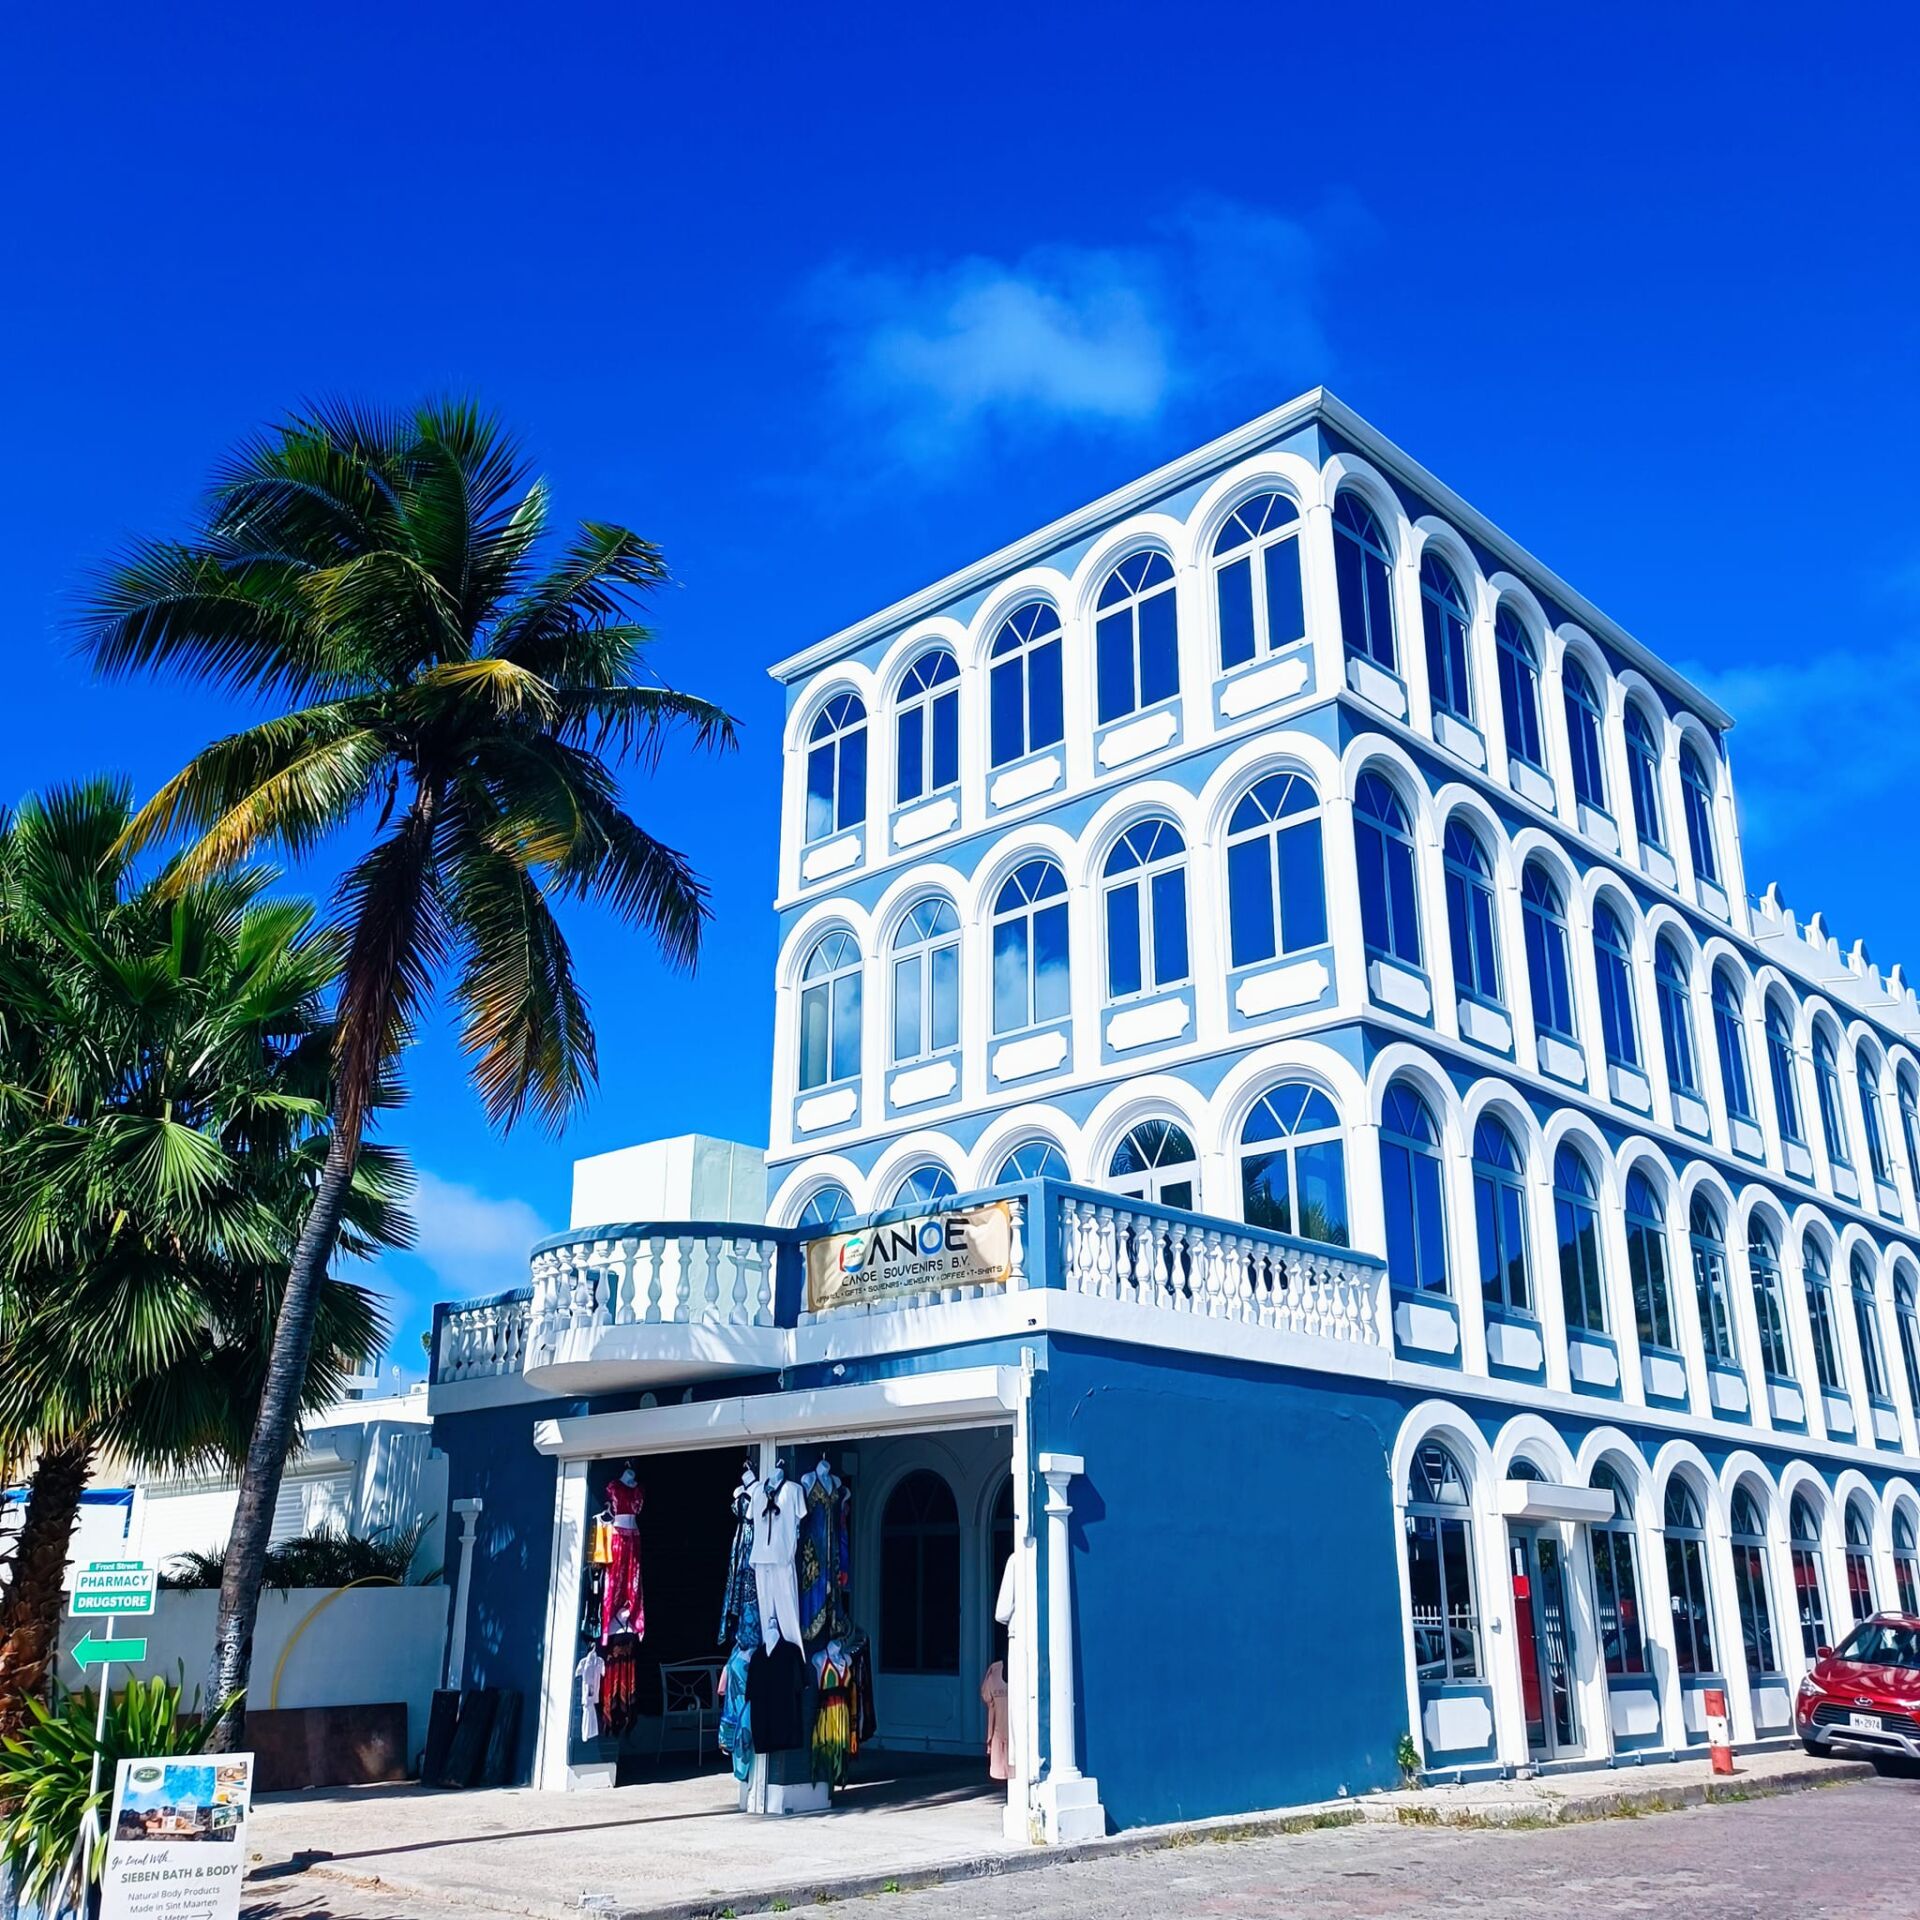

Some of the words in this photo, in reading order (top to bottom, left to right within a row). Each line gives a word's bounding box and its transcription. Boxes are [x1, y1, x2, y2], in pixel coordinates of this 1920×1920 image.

[839, 1218, 970, 1273] CANOE
[842, 1270, 878, 1287] CANOE
[883, 1259, 943, 1279] SOUVENIRS
[116, 1562, 138, 1570] Street
[80, 1575, 149, 1587] PHARMACY
[78, 1596, 148, 1608] DRUGSTORE
[125, 1853, 149, 1866] Local
[121, 1871, 160, 1884] SIEBEN
[162, 1868, 193, 1880] BATH
[195, 1867, 204, 1878] &
[206, 1864, 239, 1877] BODY
[128, 1891, 159, 1901] Natural
[161, 1889, 182, 1900] Body
[184, 1886, 220, 1896] Products
[130, 1904, 154, 1913] Made
[156, 1902, 163, 1911] in
[165, 1901, 181, 1911] Sint
[183, 1899, 218, 1909] Maarten
